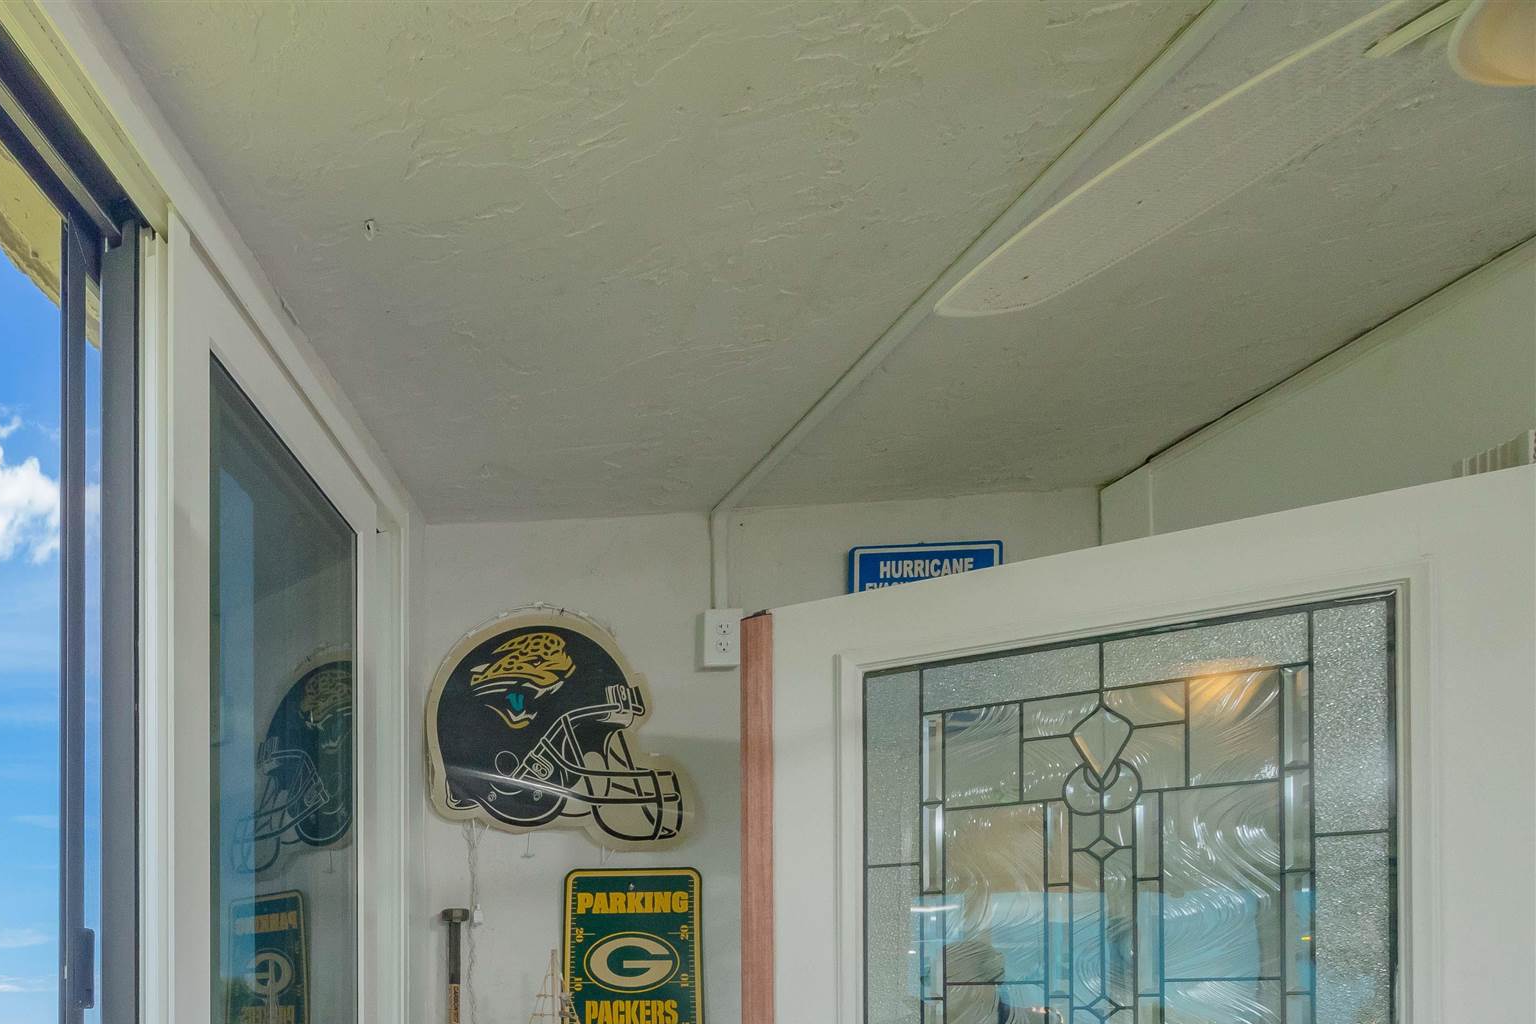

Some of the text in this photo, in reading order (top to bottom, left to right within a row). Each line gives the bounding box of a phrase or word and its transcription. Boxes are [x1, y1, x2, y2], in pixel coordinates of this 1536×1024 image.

[879, 558, 974, 578] HURRICANE
[576, 891, 689, 914] PARKING
[680, 924, 689, 940] 20
[589, 936, 674, 988] G
